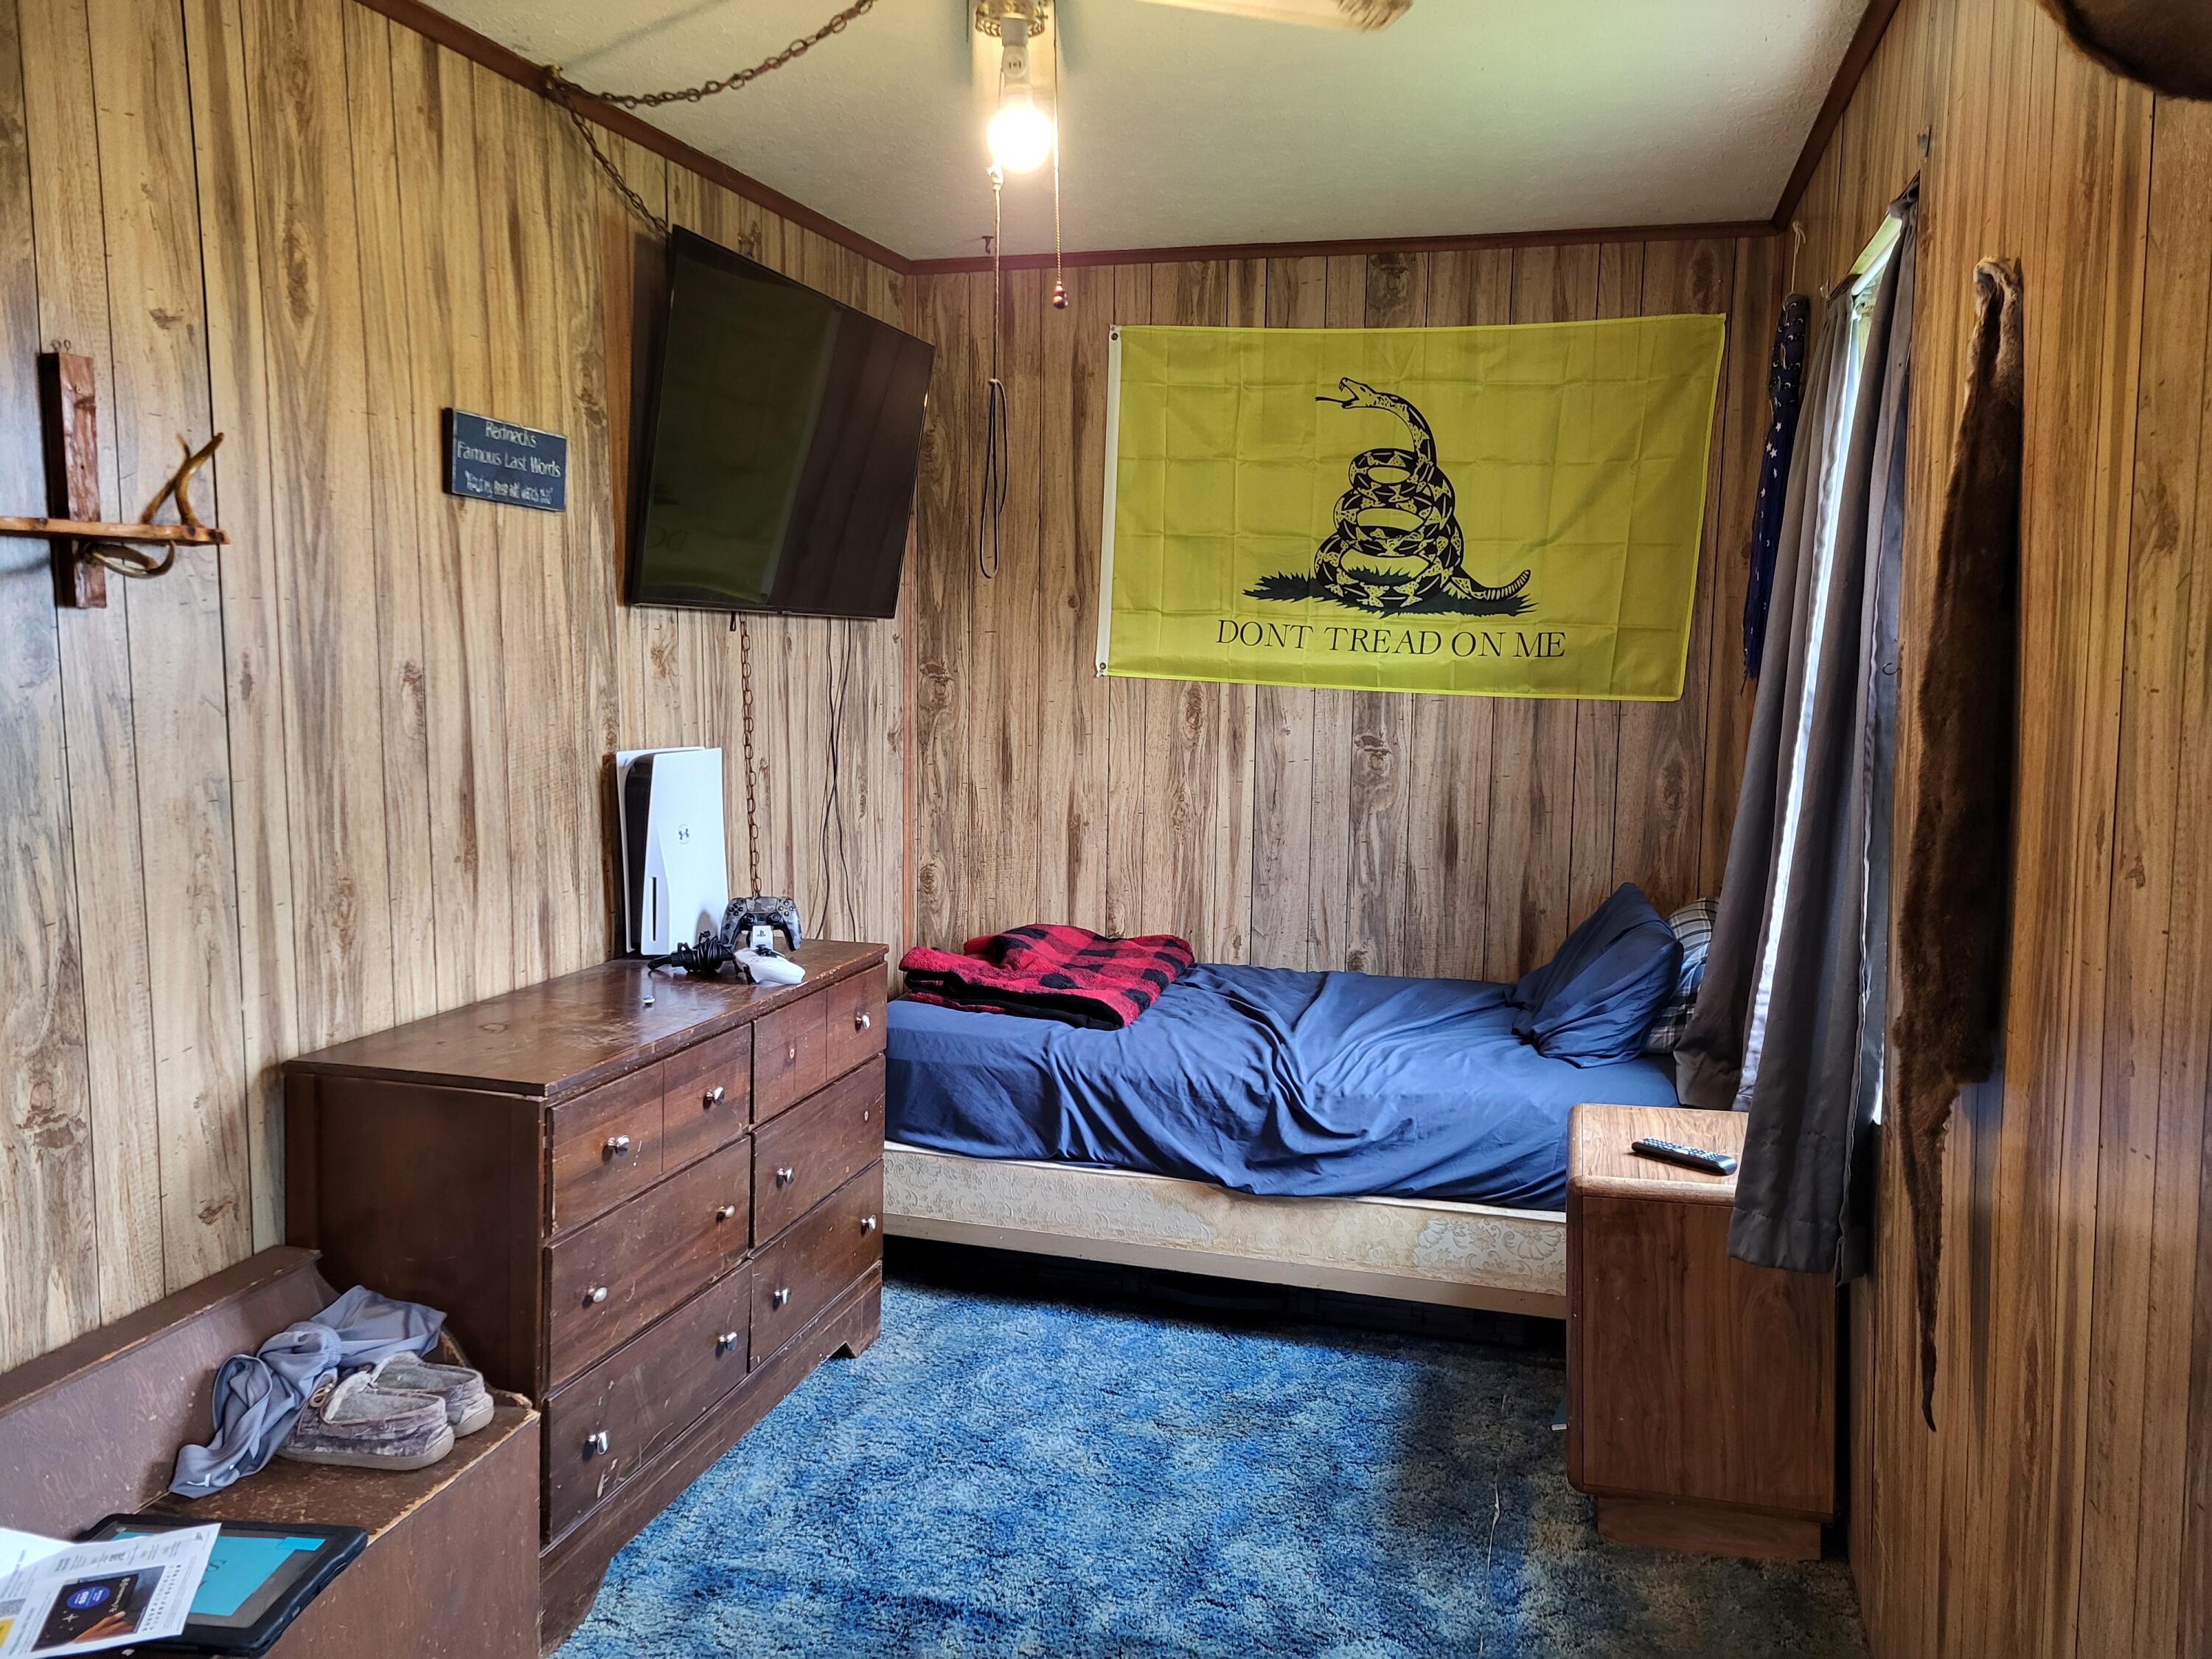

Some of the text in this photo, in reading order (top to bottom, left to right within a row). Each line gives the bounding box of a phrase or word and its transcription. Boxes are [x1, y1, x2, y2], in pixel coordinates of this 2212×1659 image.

[457, 440, 561, 478] Famous Last Words
[1215, 619, 1566, 658] DONT TREAD ON ME
